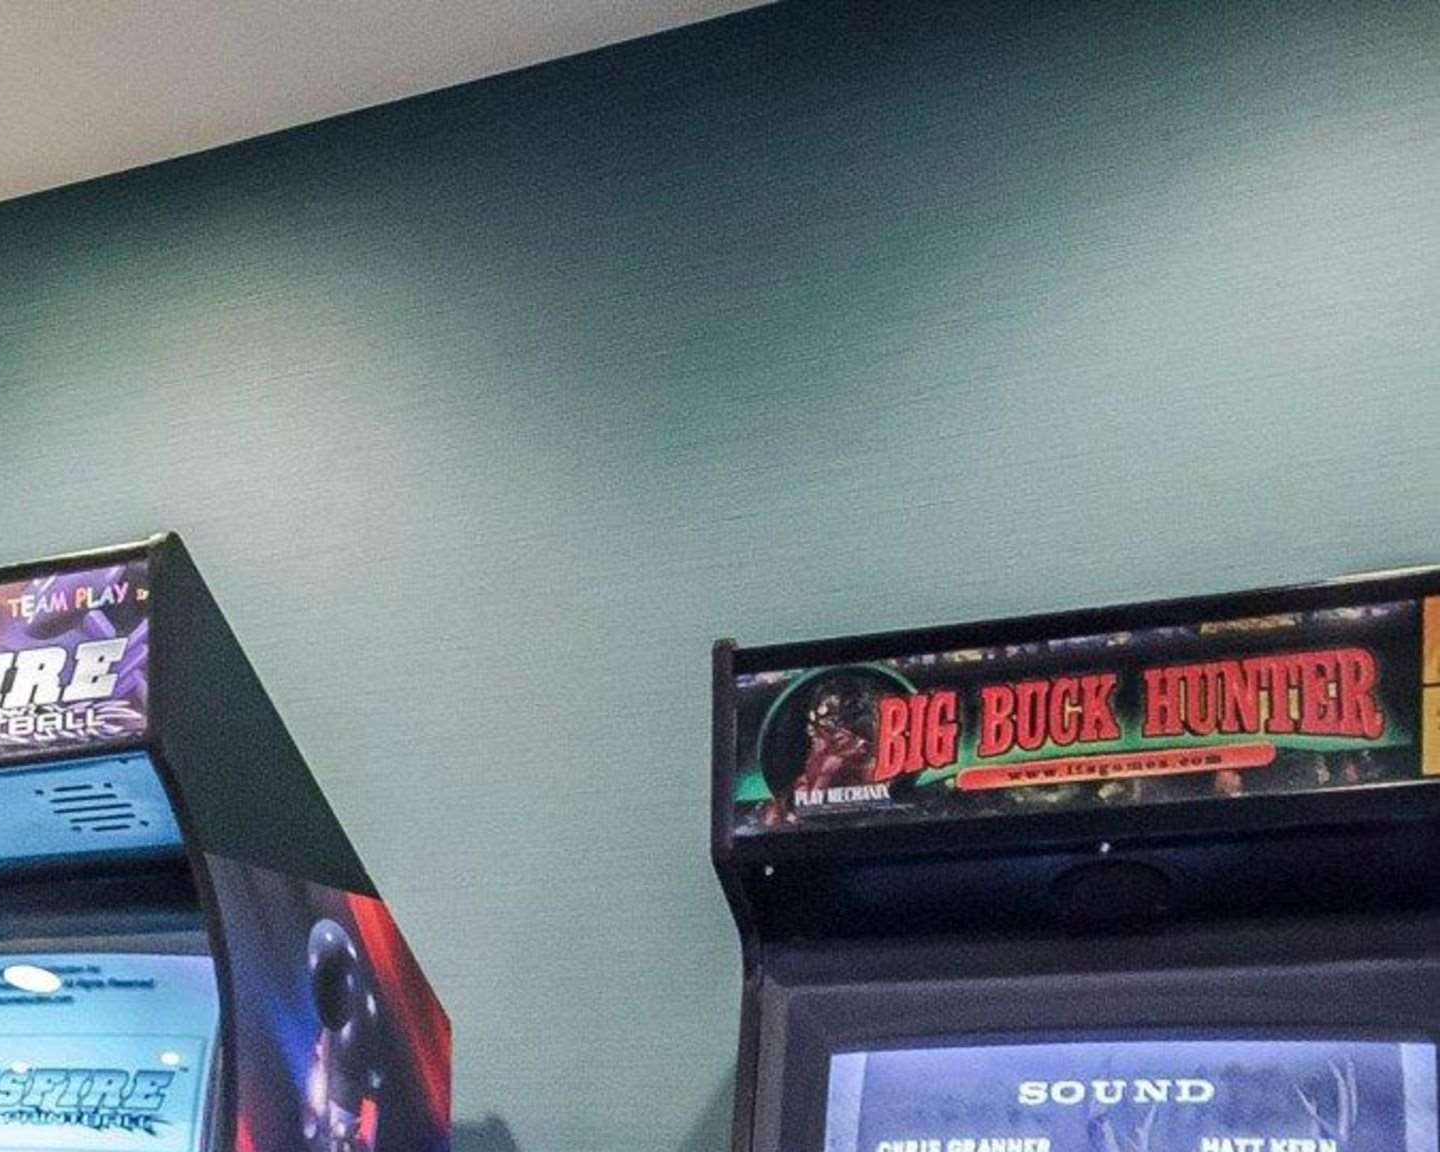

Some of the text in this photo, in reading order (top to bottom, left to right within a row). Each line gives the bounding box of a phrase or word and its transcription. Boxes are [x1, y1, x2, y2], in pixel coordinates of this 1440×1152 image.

[9, 592, 69, 620] TEAM
[74, 582, 129, 610] PLAY
[873, 647, 1385, 783] BIG BUCK HUNTER
[794, 789, 824, 807] PLAY
[1017, 1078, 1216, 1106] SOUND
